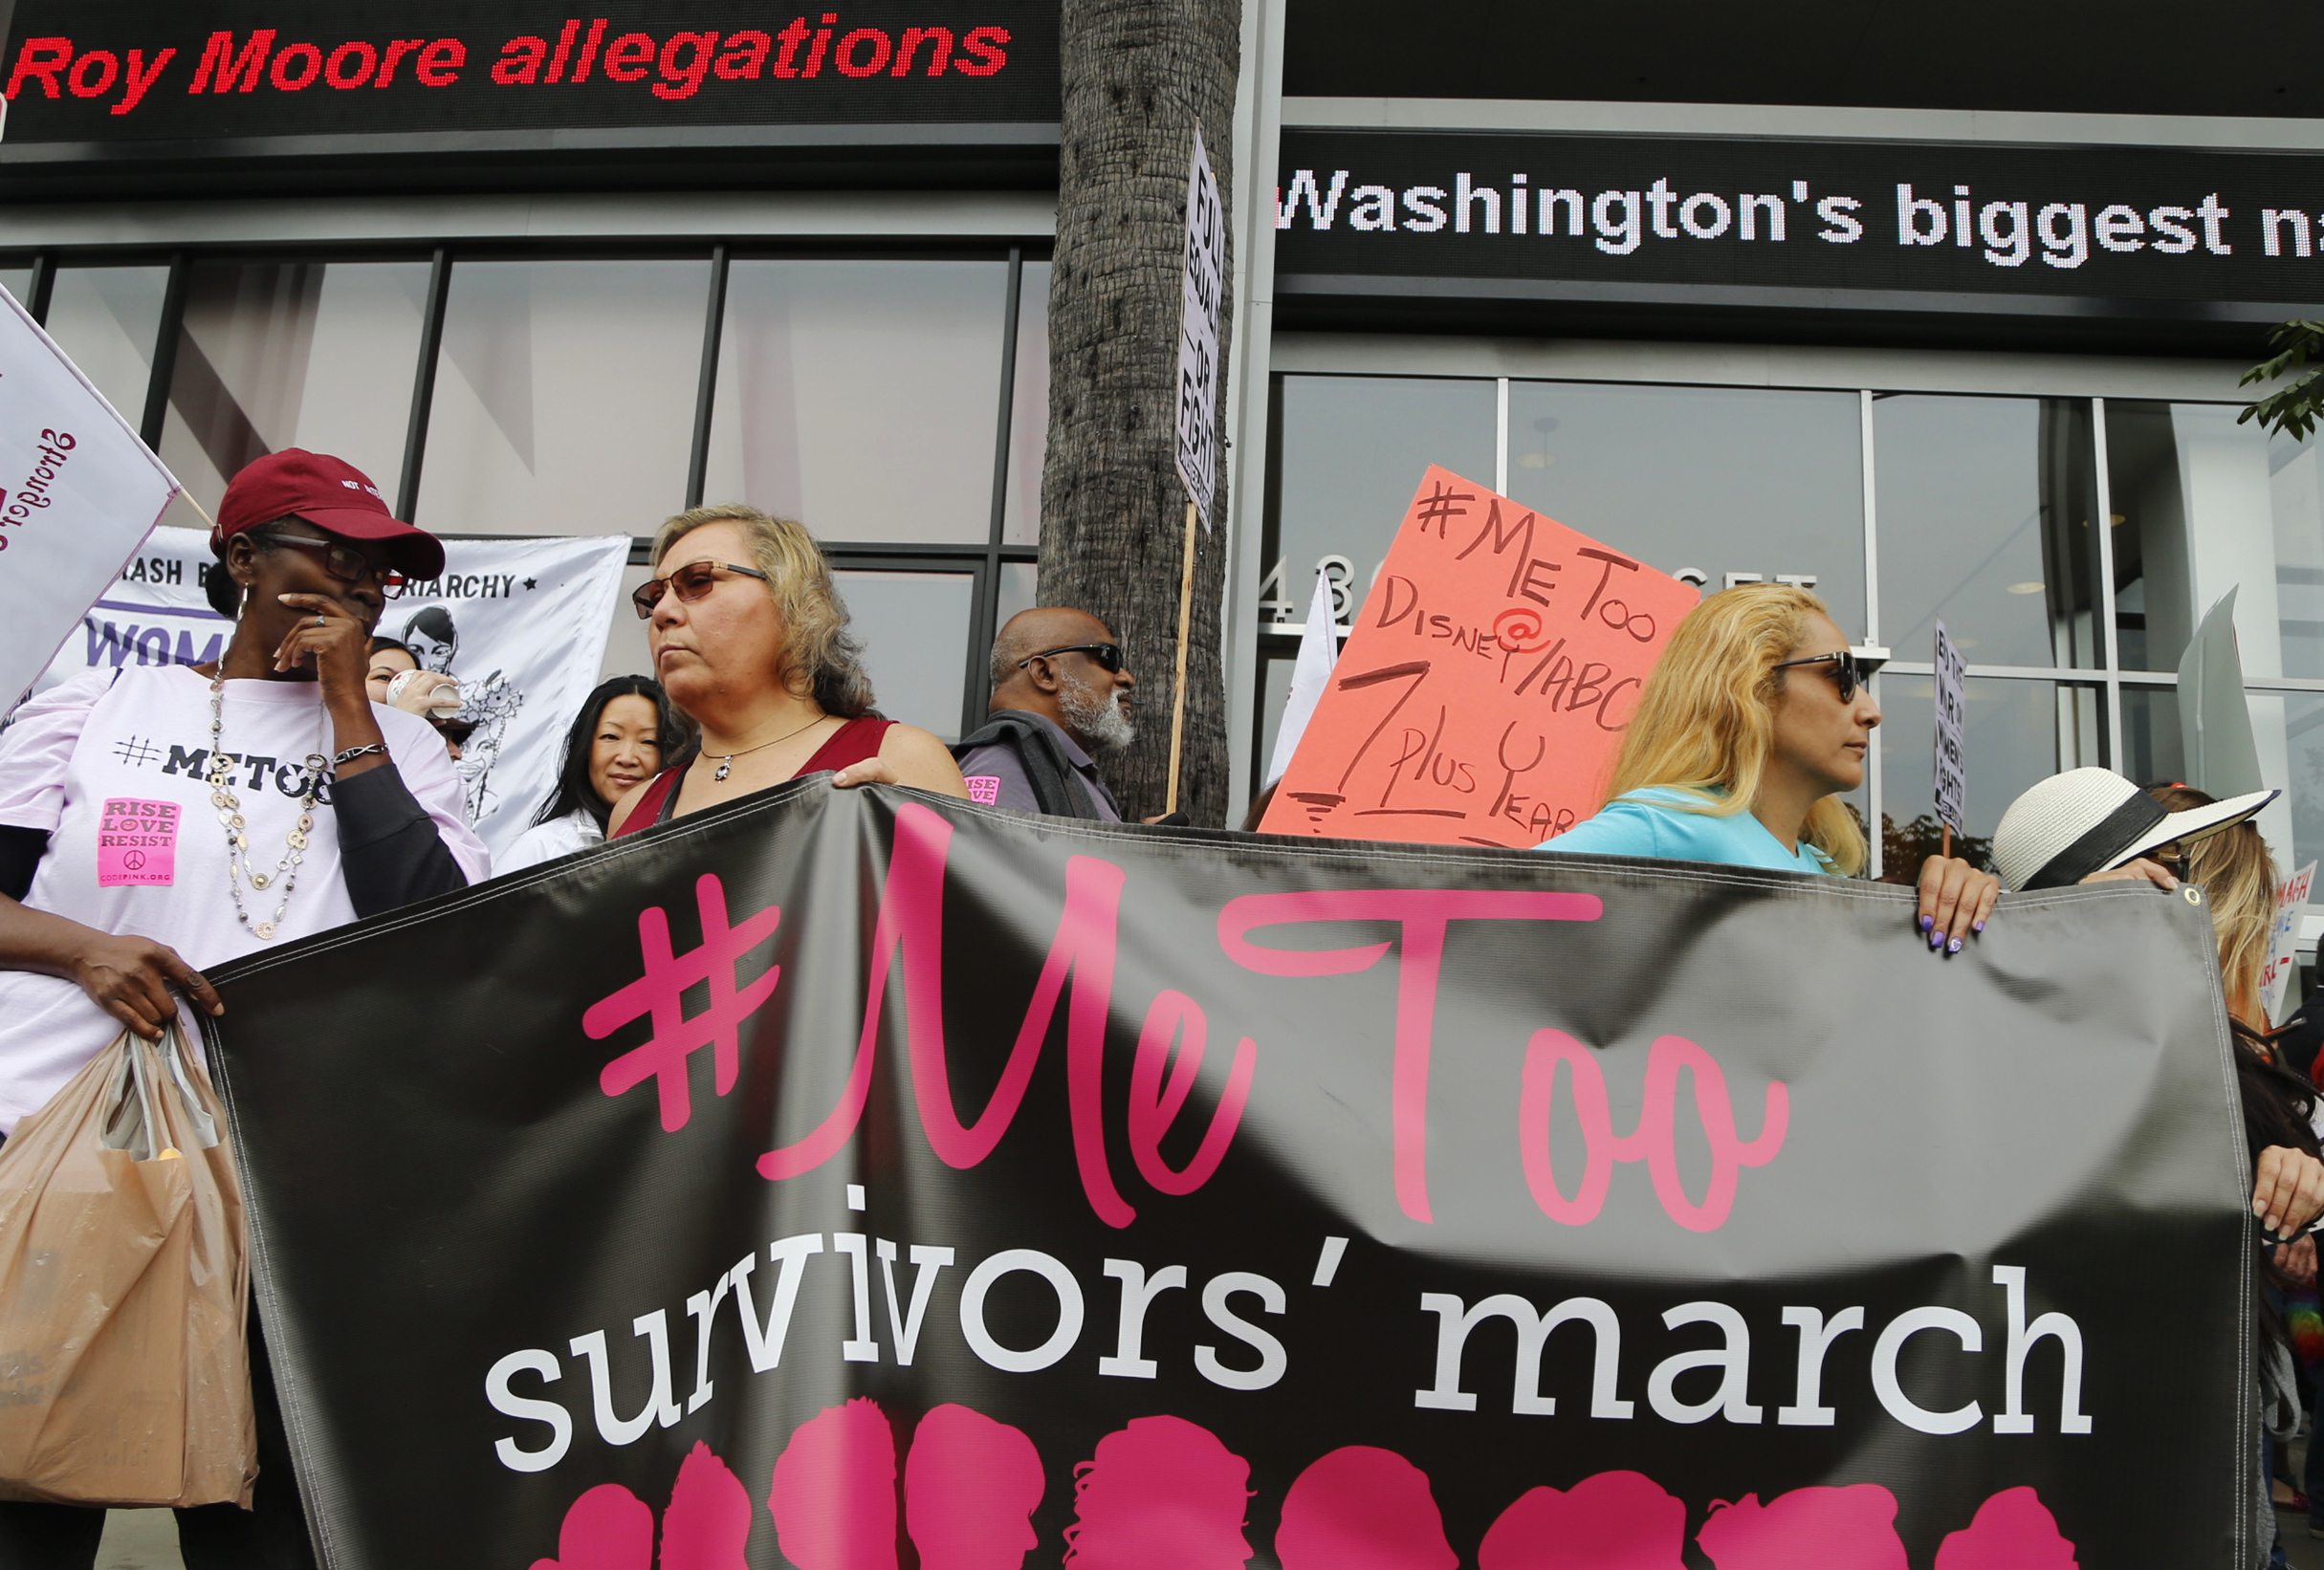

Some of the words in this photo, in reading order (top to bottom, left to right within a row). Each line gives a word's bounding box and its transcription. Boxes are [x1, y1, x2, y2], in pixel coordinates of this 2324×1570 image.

[5, 36, 177, 115] Roy
[187, 29, 467, 95] Moore
[490, 12, 1012, 100] allegations
[1275, 169, 1863, 255] Washington's
[1897, 184, 2234, 269] biggest
[2261, 208, 2324, 257] n
[1195, 339, 1211, 406] OR
[122, 557, 182, 584] ASH
[401, 574, 515, 599] RIARCHY
[84, 618, 234, 667] WOM
[101, 818, 174, 833] LOVE
[105, 801, 177, 818] RISE
[100, 835, 172, 847] RESIST
[99, 872, 170, 882] CODEPINK.ORG
[1217, 890, 1788, 1232] Too
[1414, 1265, 2093, 1436] march
